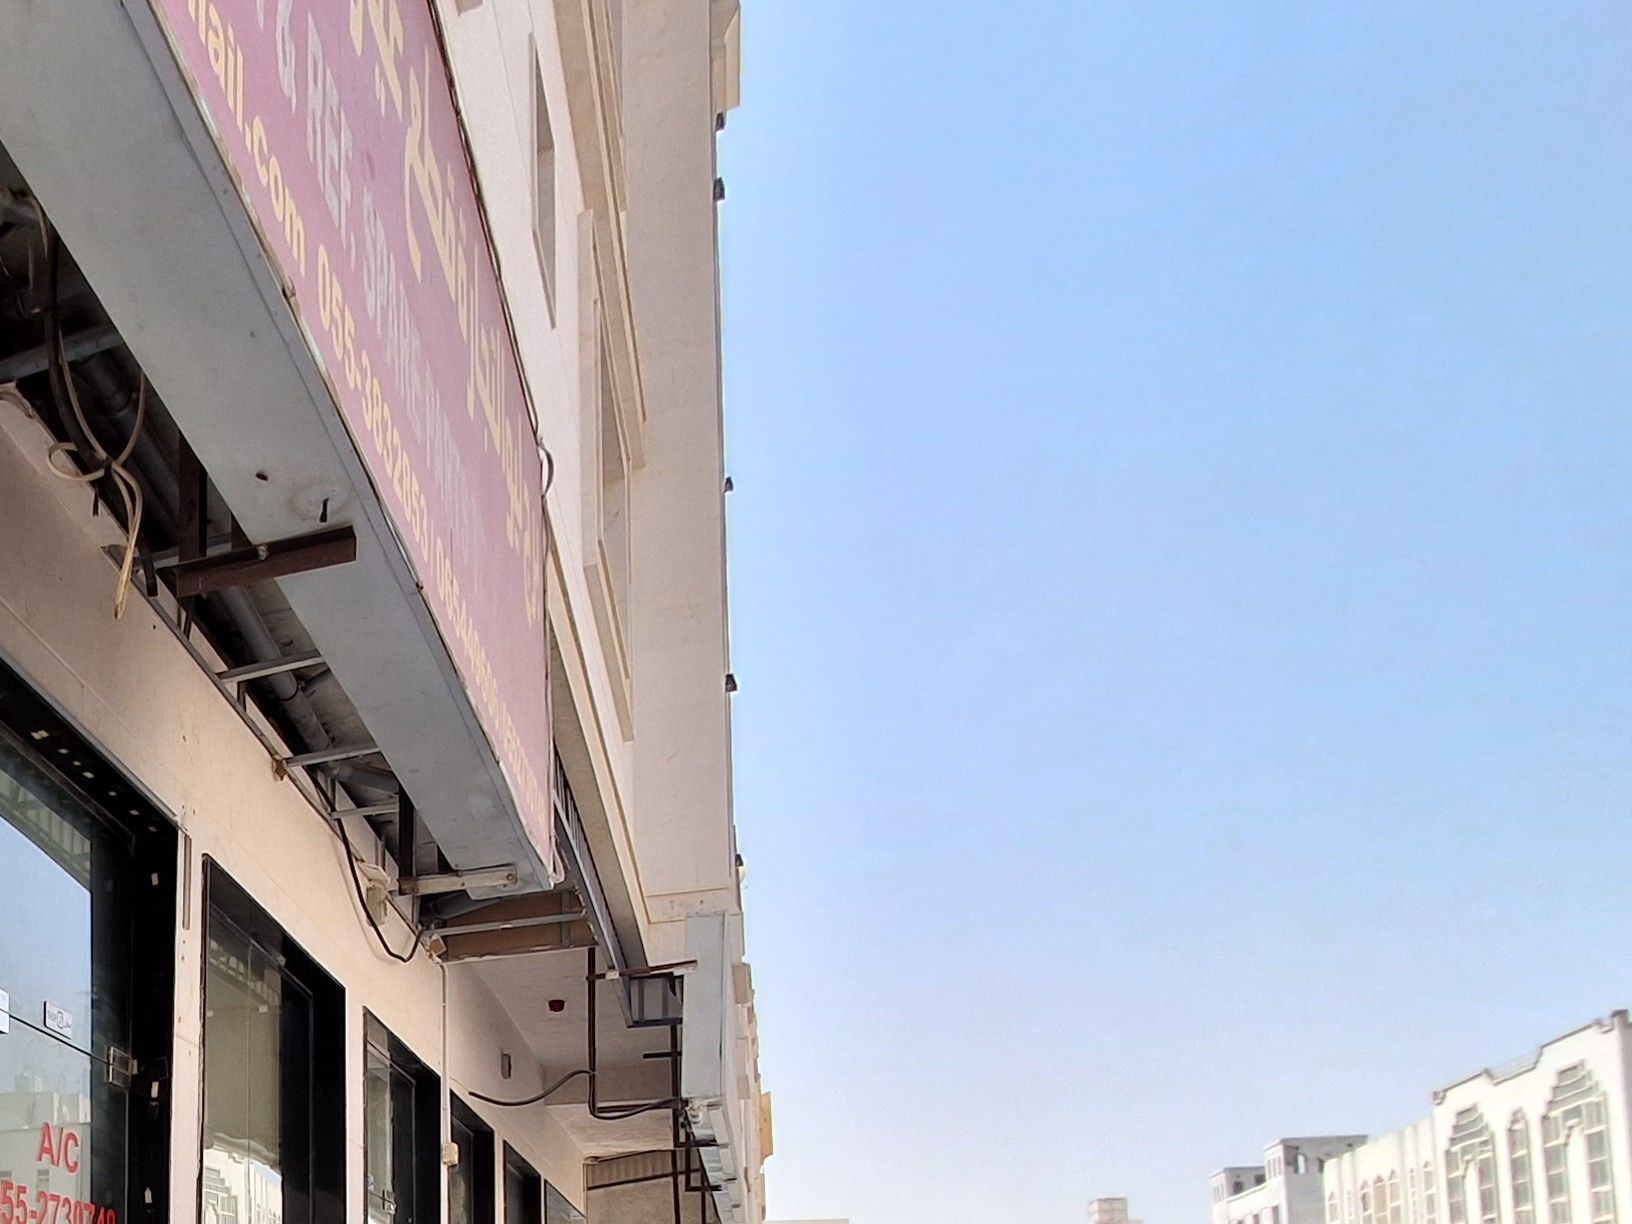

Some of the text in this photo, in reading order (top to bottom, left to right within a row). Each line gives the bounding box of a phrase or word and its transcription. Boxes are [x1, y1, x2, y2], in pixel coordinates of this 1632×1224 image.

[307, 12, 355, 272] REF.
[363, 184, 421, 440] SPARE
[404, 45, 455, 308] قطع
[37, 1122, 79, 1173] A/C
